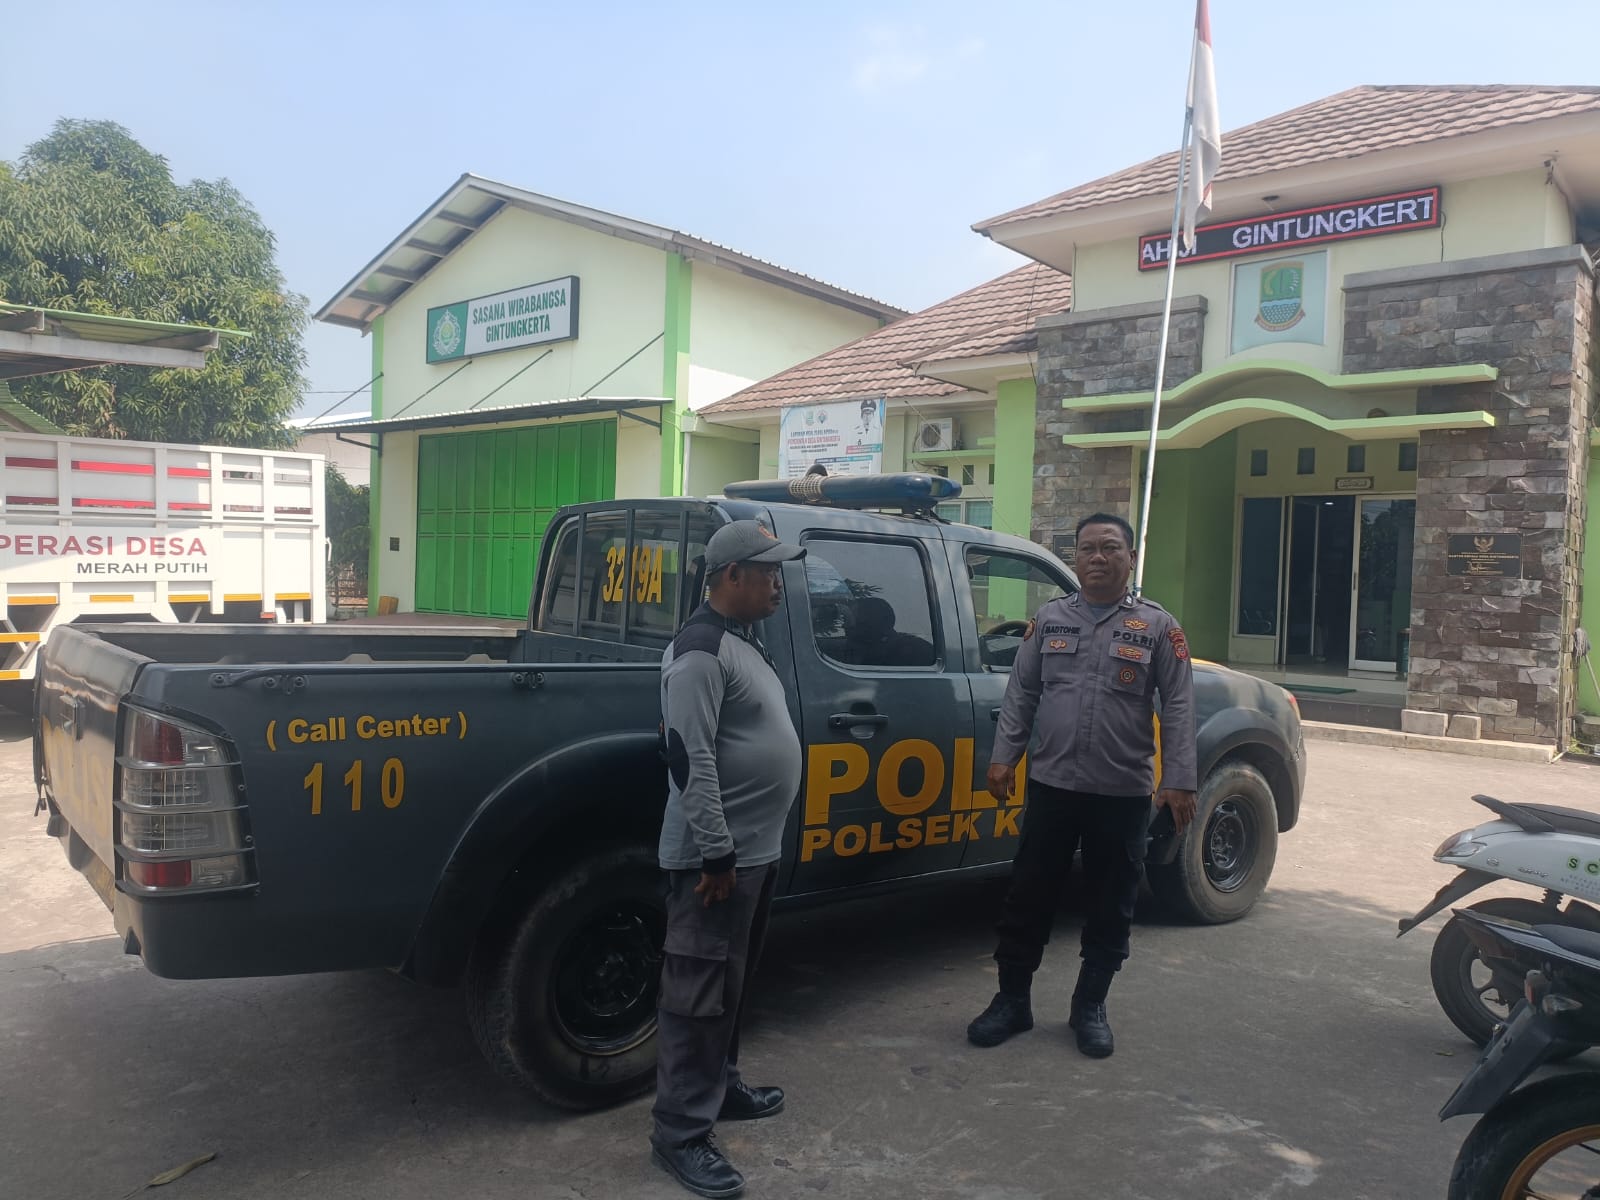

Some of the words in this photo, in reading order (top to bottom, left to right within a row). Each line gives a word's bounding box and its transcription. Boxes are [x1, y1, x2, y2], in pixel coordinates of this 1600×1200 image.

[1232, 196, 1433, 249] GINTUNGKERT
[473, 302, 505, 325] SASANA
[508, 288, 566, 317] WIRABANGSA
[486, 314, 550, 343] GINTUNGKERTA
[0, 534, 113, 556] PERASI
[126, 536, 207, 556] DESA
[77, 562, 148, 574] MERAH
[155, 562, 208, 573] PUTIH
[1112, 630, 1153, 646] POLRI
[800, 812, 982, 862] POLSEK
[1568, 855, 1600, 874] SC
